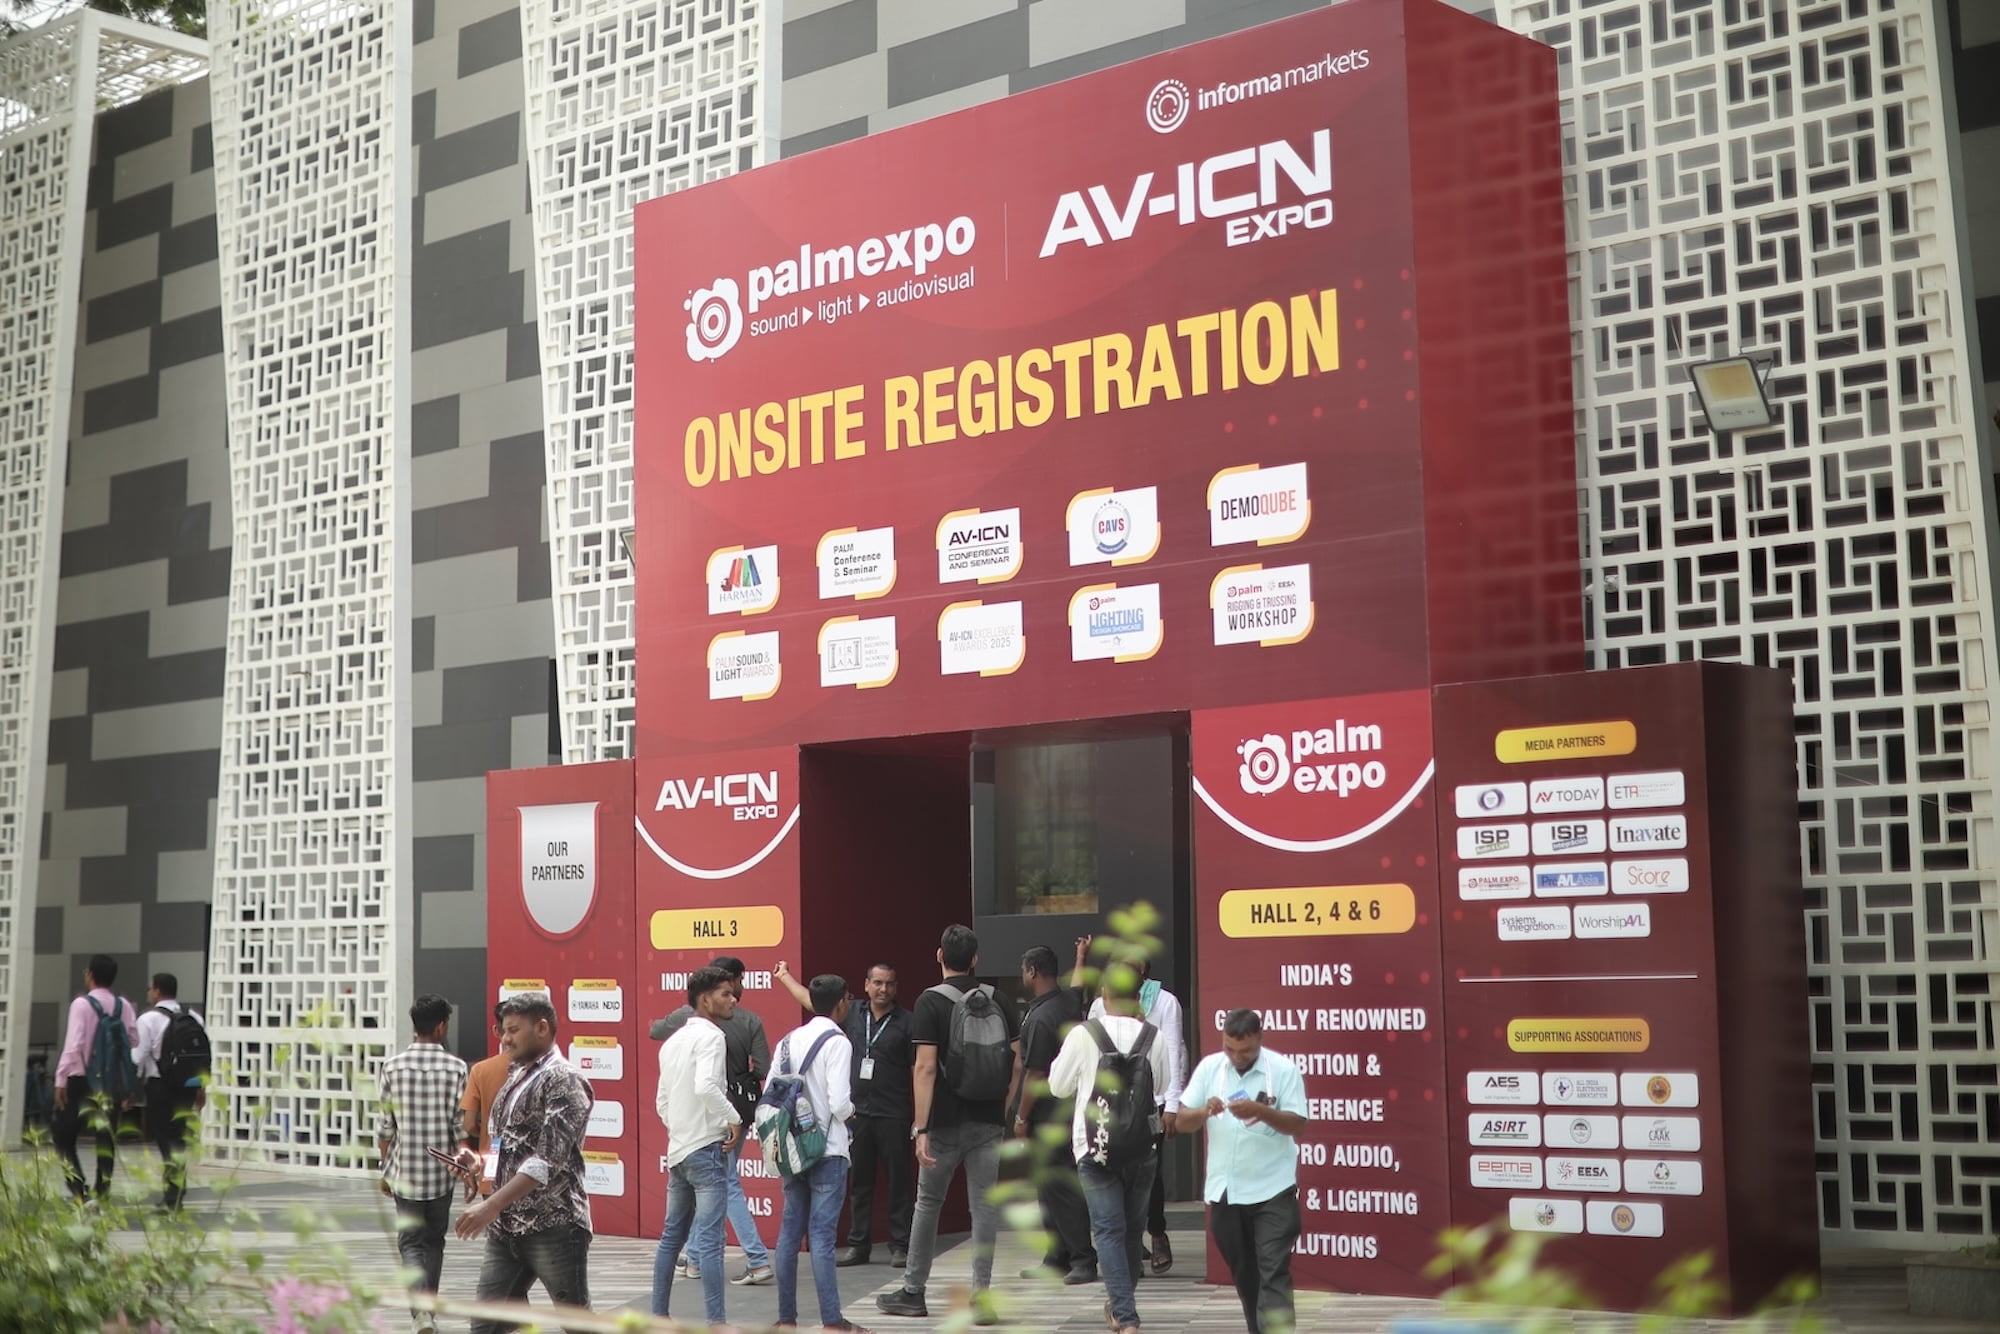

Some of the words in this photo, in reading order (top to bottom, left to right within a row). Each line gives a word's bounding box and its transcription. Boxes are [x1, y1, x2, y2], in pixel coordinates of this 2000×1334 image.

[1039, 129, 1333, 259] AV-ICN
[1226, 198, 1333, 247] EXPO
[748, 215, 976, 313] palmexpo
[750, 310, 799, 337] sound
[817, 297, 853, 325] light
[876, 266, 975, 308] audiovisual
[684, 384, 866, 488] ONSITE
[884, 289, 1340, 451] REGISTRATION
[1221, 490, 1296, 521] DEMOQUBE
[949, 524, 1010, 546] AV-ICN
[1098, 518, 1125, 534] CAVS
[833, 543, 854, 554] PALM
[948, 546, 1010, 561] CONFERENCE
[833, 552, 882, 566] Conference
[949, 562, 968, 570] AND
[970, 556, 1010, 568] SEMINAR
[834, 567, 841, 577] &
[843, 563, 878, 576] Seminar
[719, 589, 763, 603] HARMAN
[1238, 583, 1262, 597] palm
[1227, 598, 1255, 612] RIGGING
[1256, 598, 1262, 609] &
[1262, 594, 1297, 609] TRUSSING
[1089, 607, 1143, 628] LIGHTING
[1228, 608, 1297, 631] WORKSHOP
[990, 636, 1011, 650] 2025
[715, 656, 736, 670] PALM
[736, 652, 763, 667] SOUND
[715, 667, 742, 682] LIGHT
[742, 664, 774, 678] AWARDS
[1291, 719, 1382, 763] palm
[1525, 739, 1554, 751] MEDIA
[1557, 735, 1605, 748] PARTNERS
[1293, 760, 1386, 798] expo
[655, 770, 777, 811] AV-ICN
[1535, 791, 1554, 804] AV
[1556, 788, 1600, 802] TODAY
[733, 804, 777, 821] EXPO
[1475, 829, 1509, 845] ISP
[1551, 824, 1588, 841] ISP
[1616, 824, 1681, 843] Inavate
[547, 841, 568, 857] OUR
[532, 864, 584, 881] PARTNERS
[1479, 876, 1498, 884] PALM
[1627, 865, 1671, 887] Score
[1251, 903, 1297, 924] HALL
[1304, 902, 1321, 925] 2,
[1329, 901, 1341, 921] 4
[1348, 900, 1362, 921] &
[1369, 900, 1380, 920] 6
[693, 921, 725, 937] HALL
[730, 920, 738, 937] 3
[661, 973, 693, 991] INDI
[741, 971, 772, 990] MIER
[1280, 964, 1352, 986] INDIA'S
[579, 1001, 599, 1010] YAMAHA
[1214, 1009, 1309, 1031] GALLY
[1316, 1008, 1426, 1032] RENOWNED
[1514, 1031, 1572, 1042] SUPPORTING
[1574, 1031, 1642, 1042] ASSOCIATIONS
[1285, 1054, 1359, 1076] BITION
[1366, 1054, 1381, 1076] &
[1485, 1076, 1520, 1088] AES
[1306, 1099, 1383, 1121] ERENCE
[1483, 1120, 1526, 1132] ASIRT
[1296, 1144, 1327, 1166] RO
[1333, 1145, 1400, 1173] AUDIO,
[1478, 1161, 1532, 1174] eema
[1577, 1166, 1608, 1177] EESA
[1306, 1188, 1320, 1211] &
[1327, 1189, 1418, 1215] LIGHTING
[1292, 1233, 1378, 1259] LUTIONS
